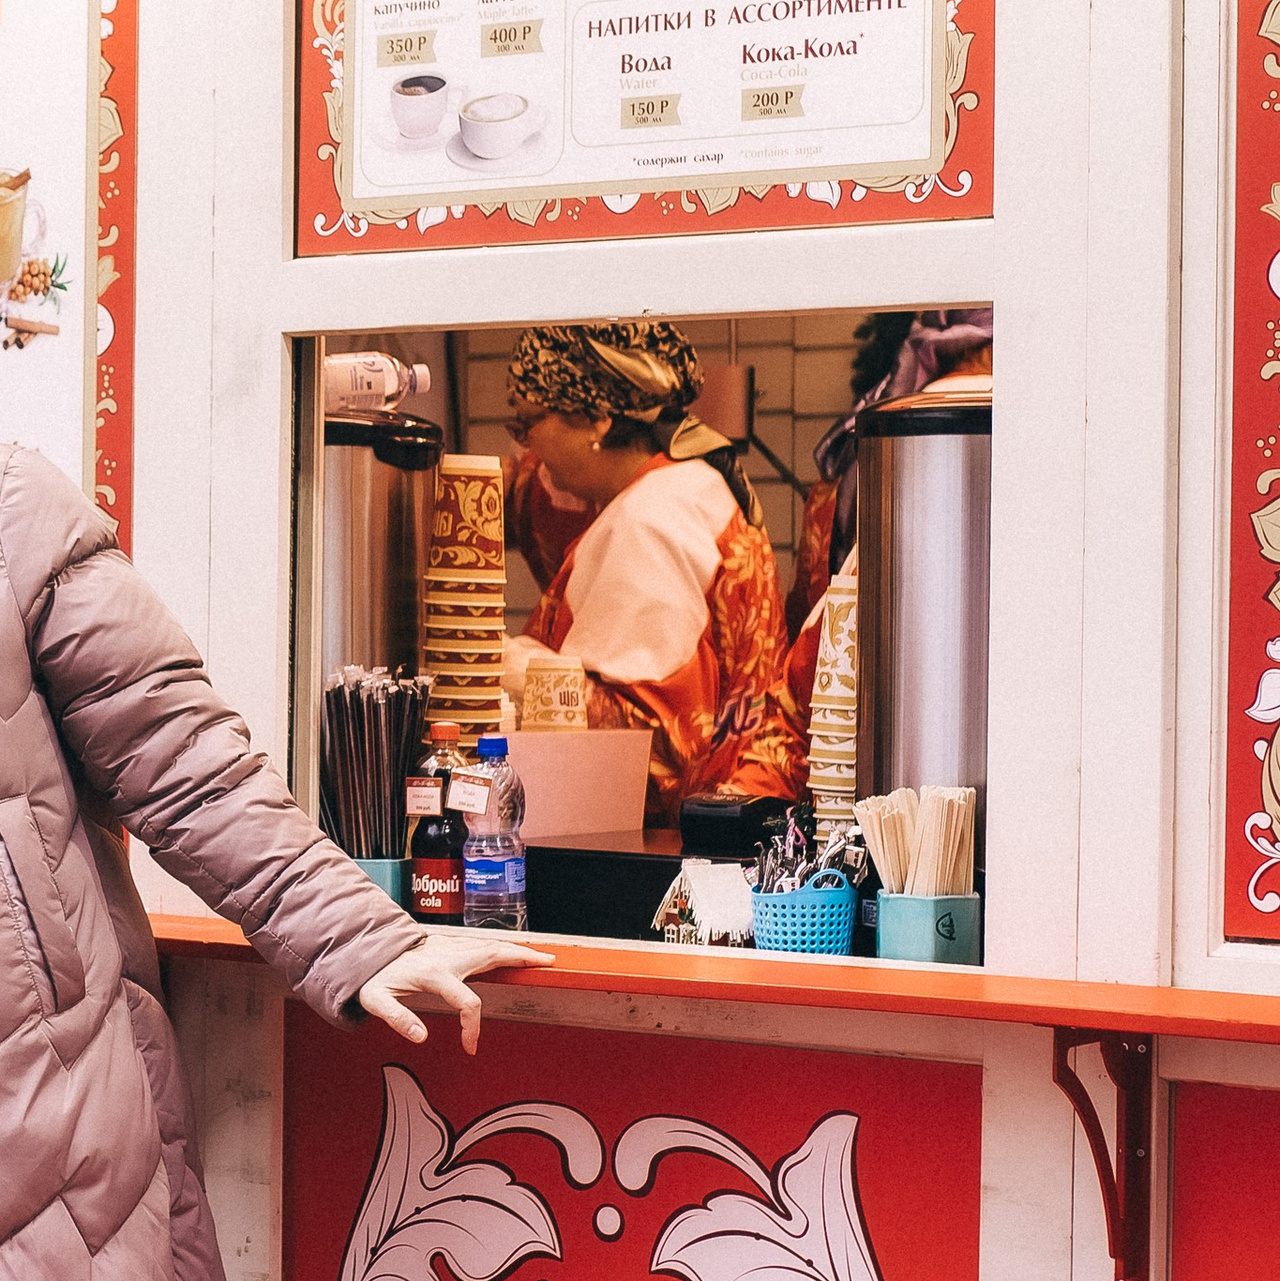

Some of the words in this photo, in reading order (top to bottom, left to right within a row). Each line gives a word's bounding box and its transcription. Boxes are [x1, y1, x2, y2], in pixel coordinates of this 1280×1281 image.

[374, 0, 441, 17] капучино
[588, 11, 692, 38] НАПИТКИ
[705, 8, 716, 27] В
[490, 26, 518, 44] 400
[387, 37, 413, 55] 350
[620, 53, 673, 74] Вода
[740, 64, 808, 82] Coca-Cola
[619, 77, 658, 91] Water
[629, 101, 655, 116] 150
[752, 92, 779, 108] 200
[693, 152, 724, 165] сахар
[420, 895, 442, 907] cola
